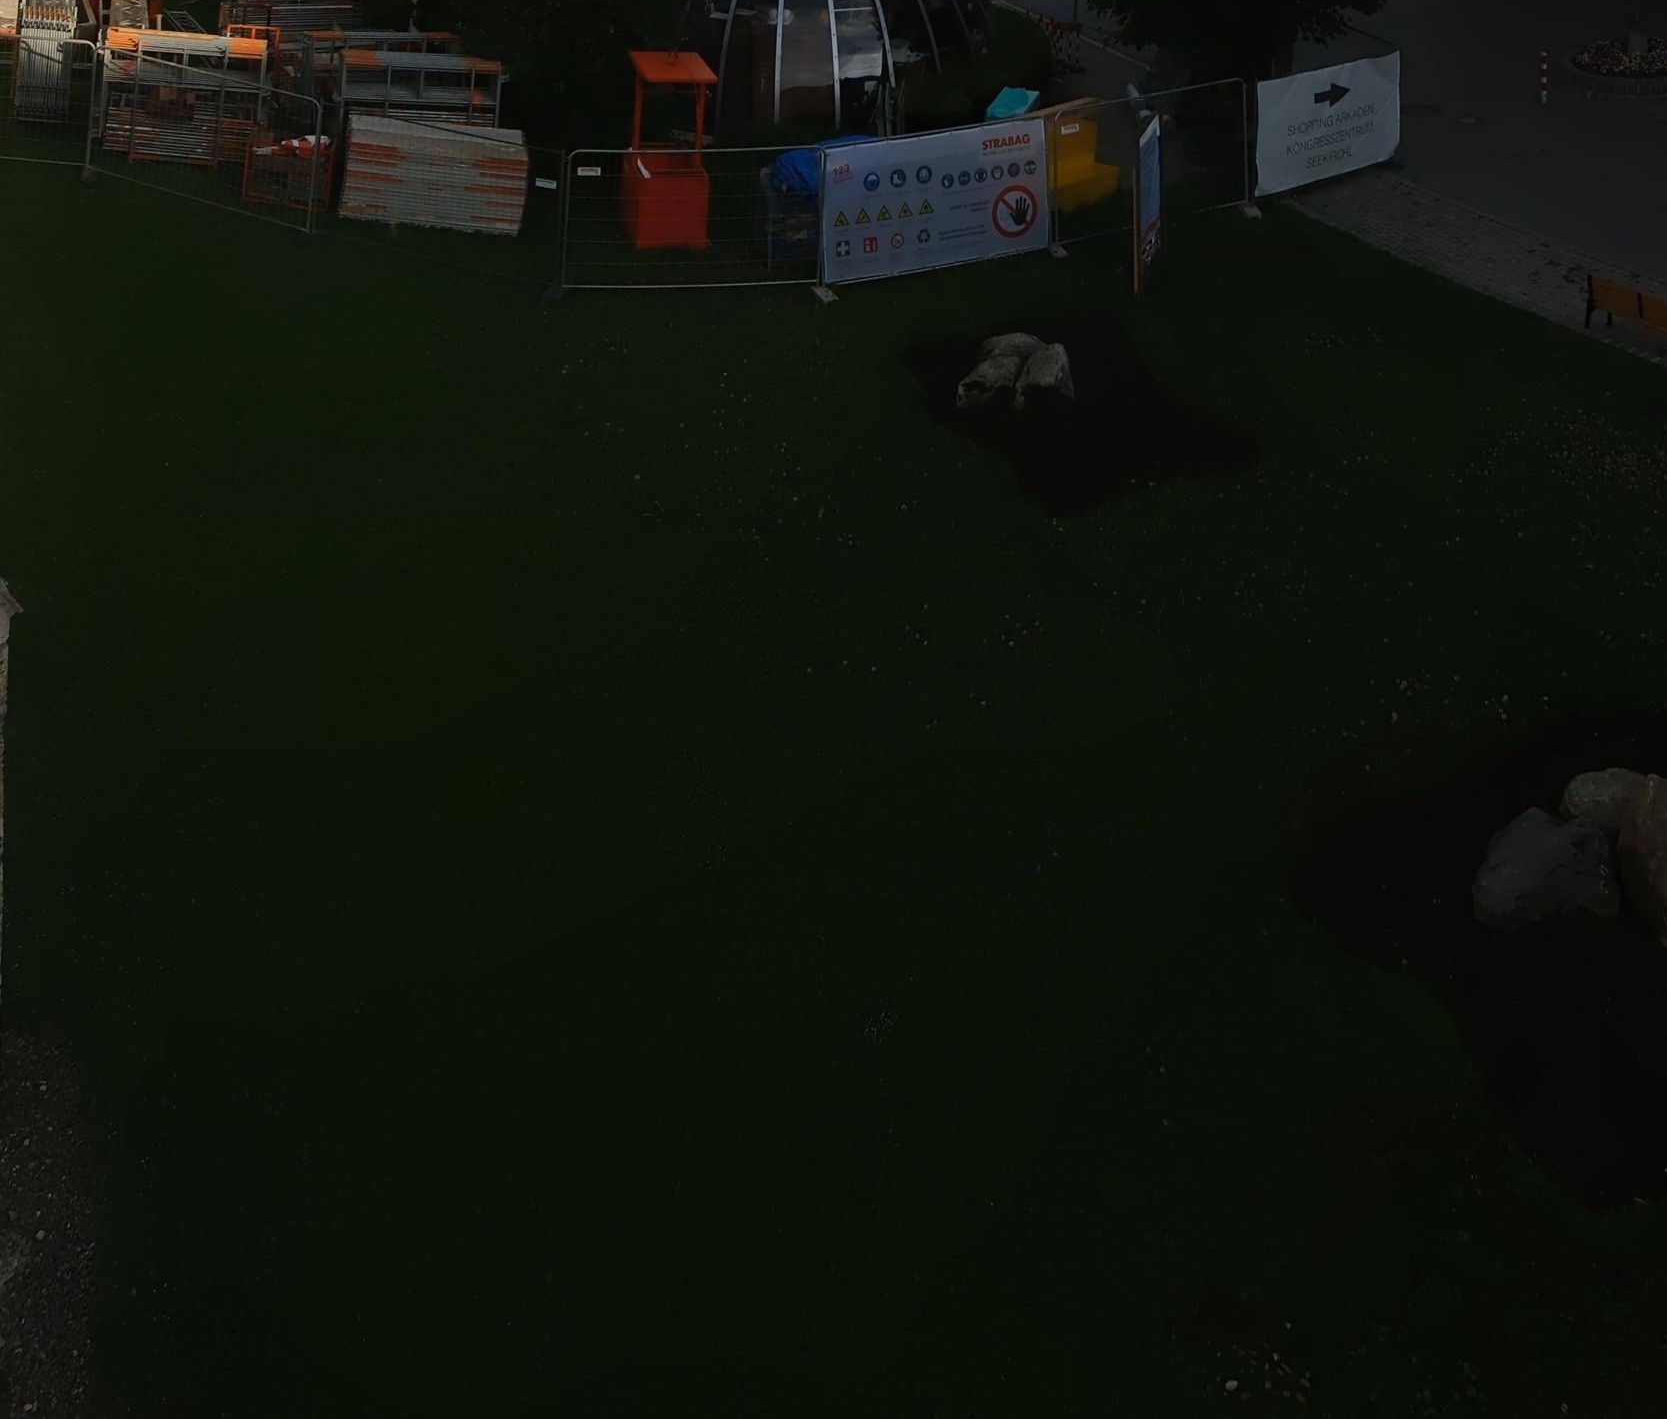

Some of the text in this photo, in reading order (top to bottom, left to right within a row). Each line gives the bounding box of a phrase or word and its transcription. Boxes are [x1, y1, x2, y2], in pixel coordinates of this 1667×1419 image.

[1288, 104, 1375, 137] SHOPPING ARKADEN
[982, 134, 1031, 151] STRABAG
[1286, 122, 1375, 156] KONGRESSZENTRUM
[1306, 147, 1353, 169] SEEKIRCHL
